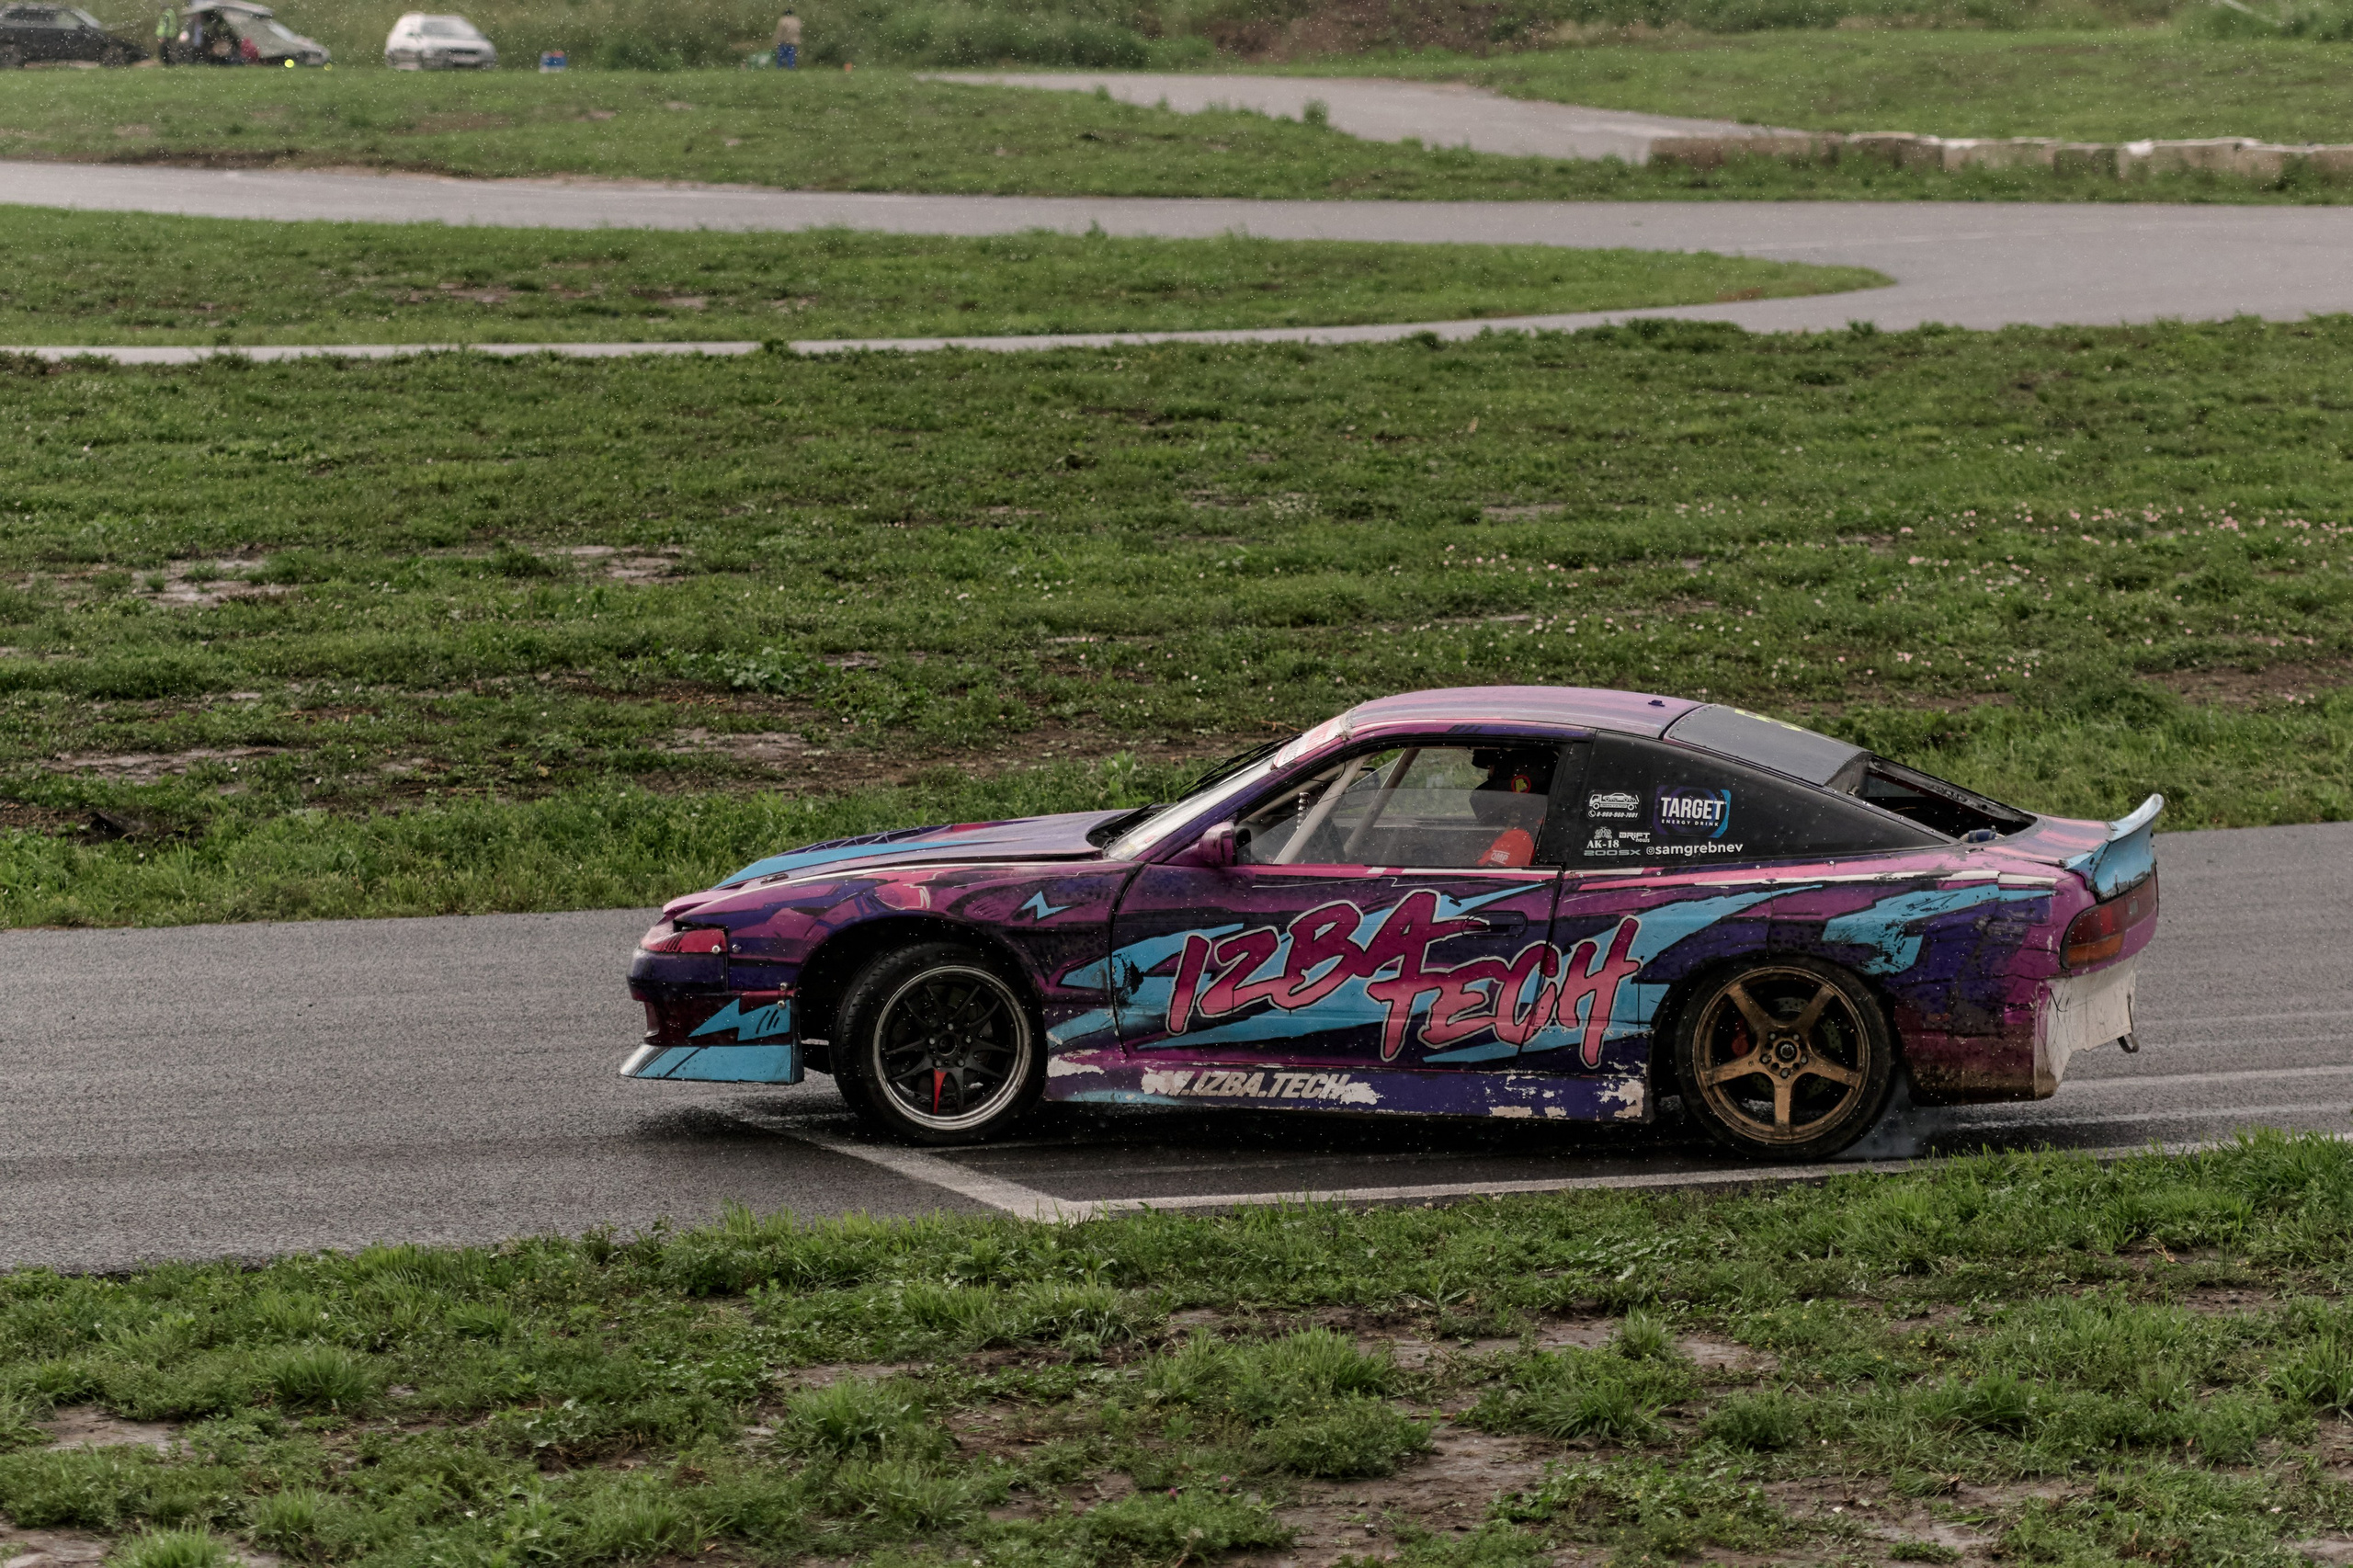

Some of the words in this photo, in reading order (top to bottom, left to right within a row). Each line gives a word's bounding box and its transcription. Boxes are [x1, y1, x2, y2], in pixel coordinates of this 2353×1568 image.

[1661, 797, 1725, 820] TARGET
[1586, 839, 1620, 848] AK-18
[1491, 852, 1508, 863] OMP
[1367, 915, 1643, 1069] TECH
